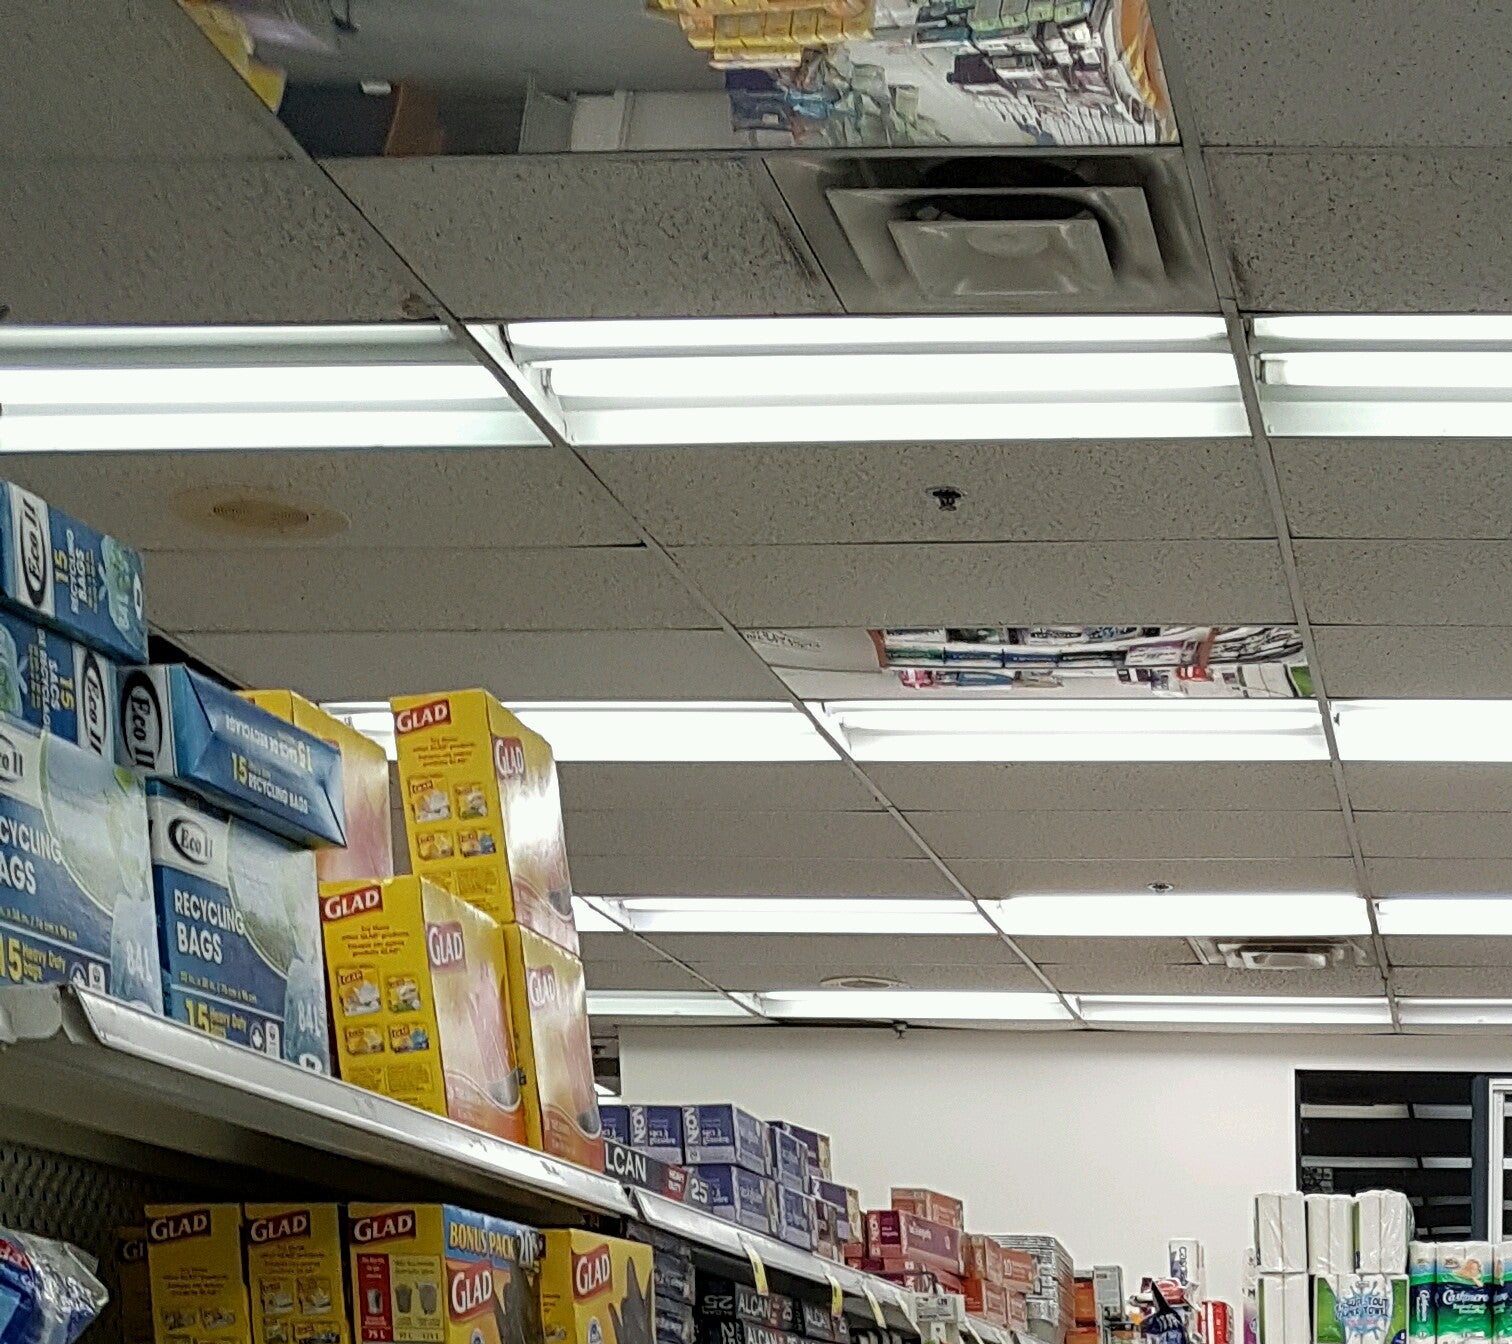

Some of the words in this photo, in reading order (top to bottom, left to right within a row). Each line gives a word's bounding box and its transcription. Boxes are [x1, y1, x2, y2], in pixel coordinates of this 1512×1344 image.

[397, 701, 449, 732] GLAD
[495, 740, 524, 776] GLAD
[174, 888, 245, 934] RECYCLING
[323, 889, 380, 917] GLAD
[176, 922, 223, 964] BAGS
[429, 926, 462, 967] GLAD
[529, 971, 556, 1004] GLAD
[690, 1178, 710, 1203] 25
[150, 1213, 208, 1241] GLAD
[251, 1215, 307, 1242] GLAD
[354, 1215, 413, 1242] GLAD
[450, 1225, 486, 1253] BONUS
[575, 1256, 610, 1295] GLAD
[452, 1270, 492, 1314] GLAD
[739, 1293, 771, 1320] ALCAN
